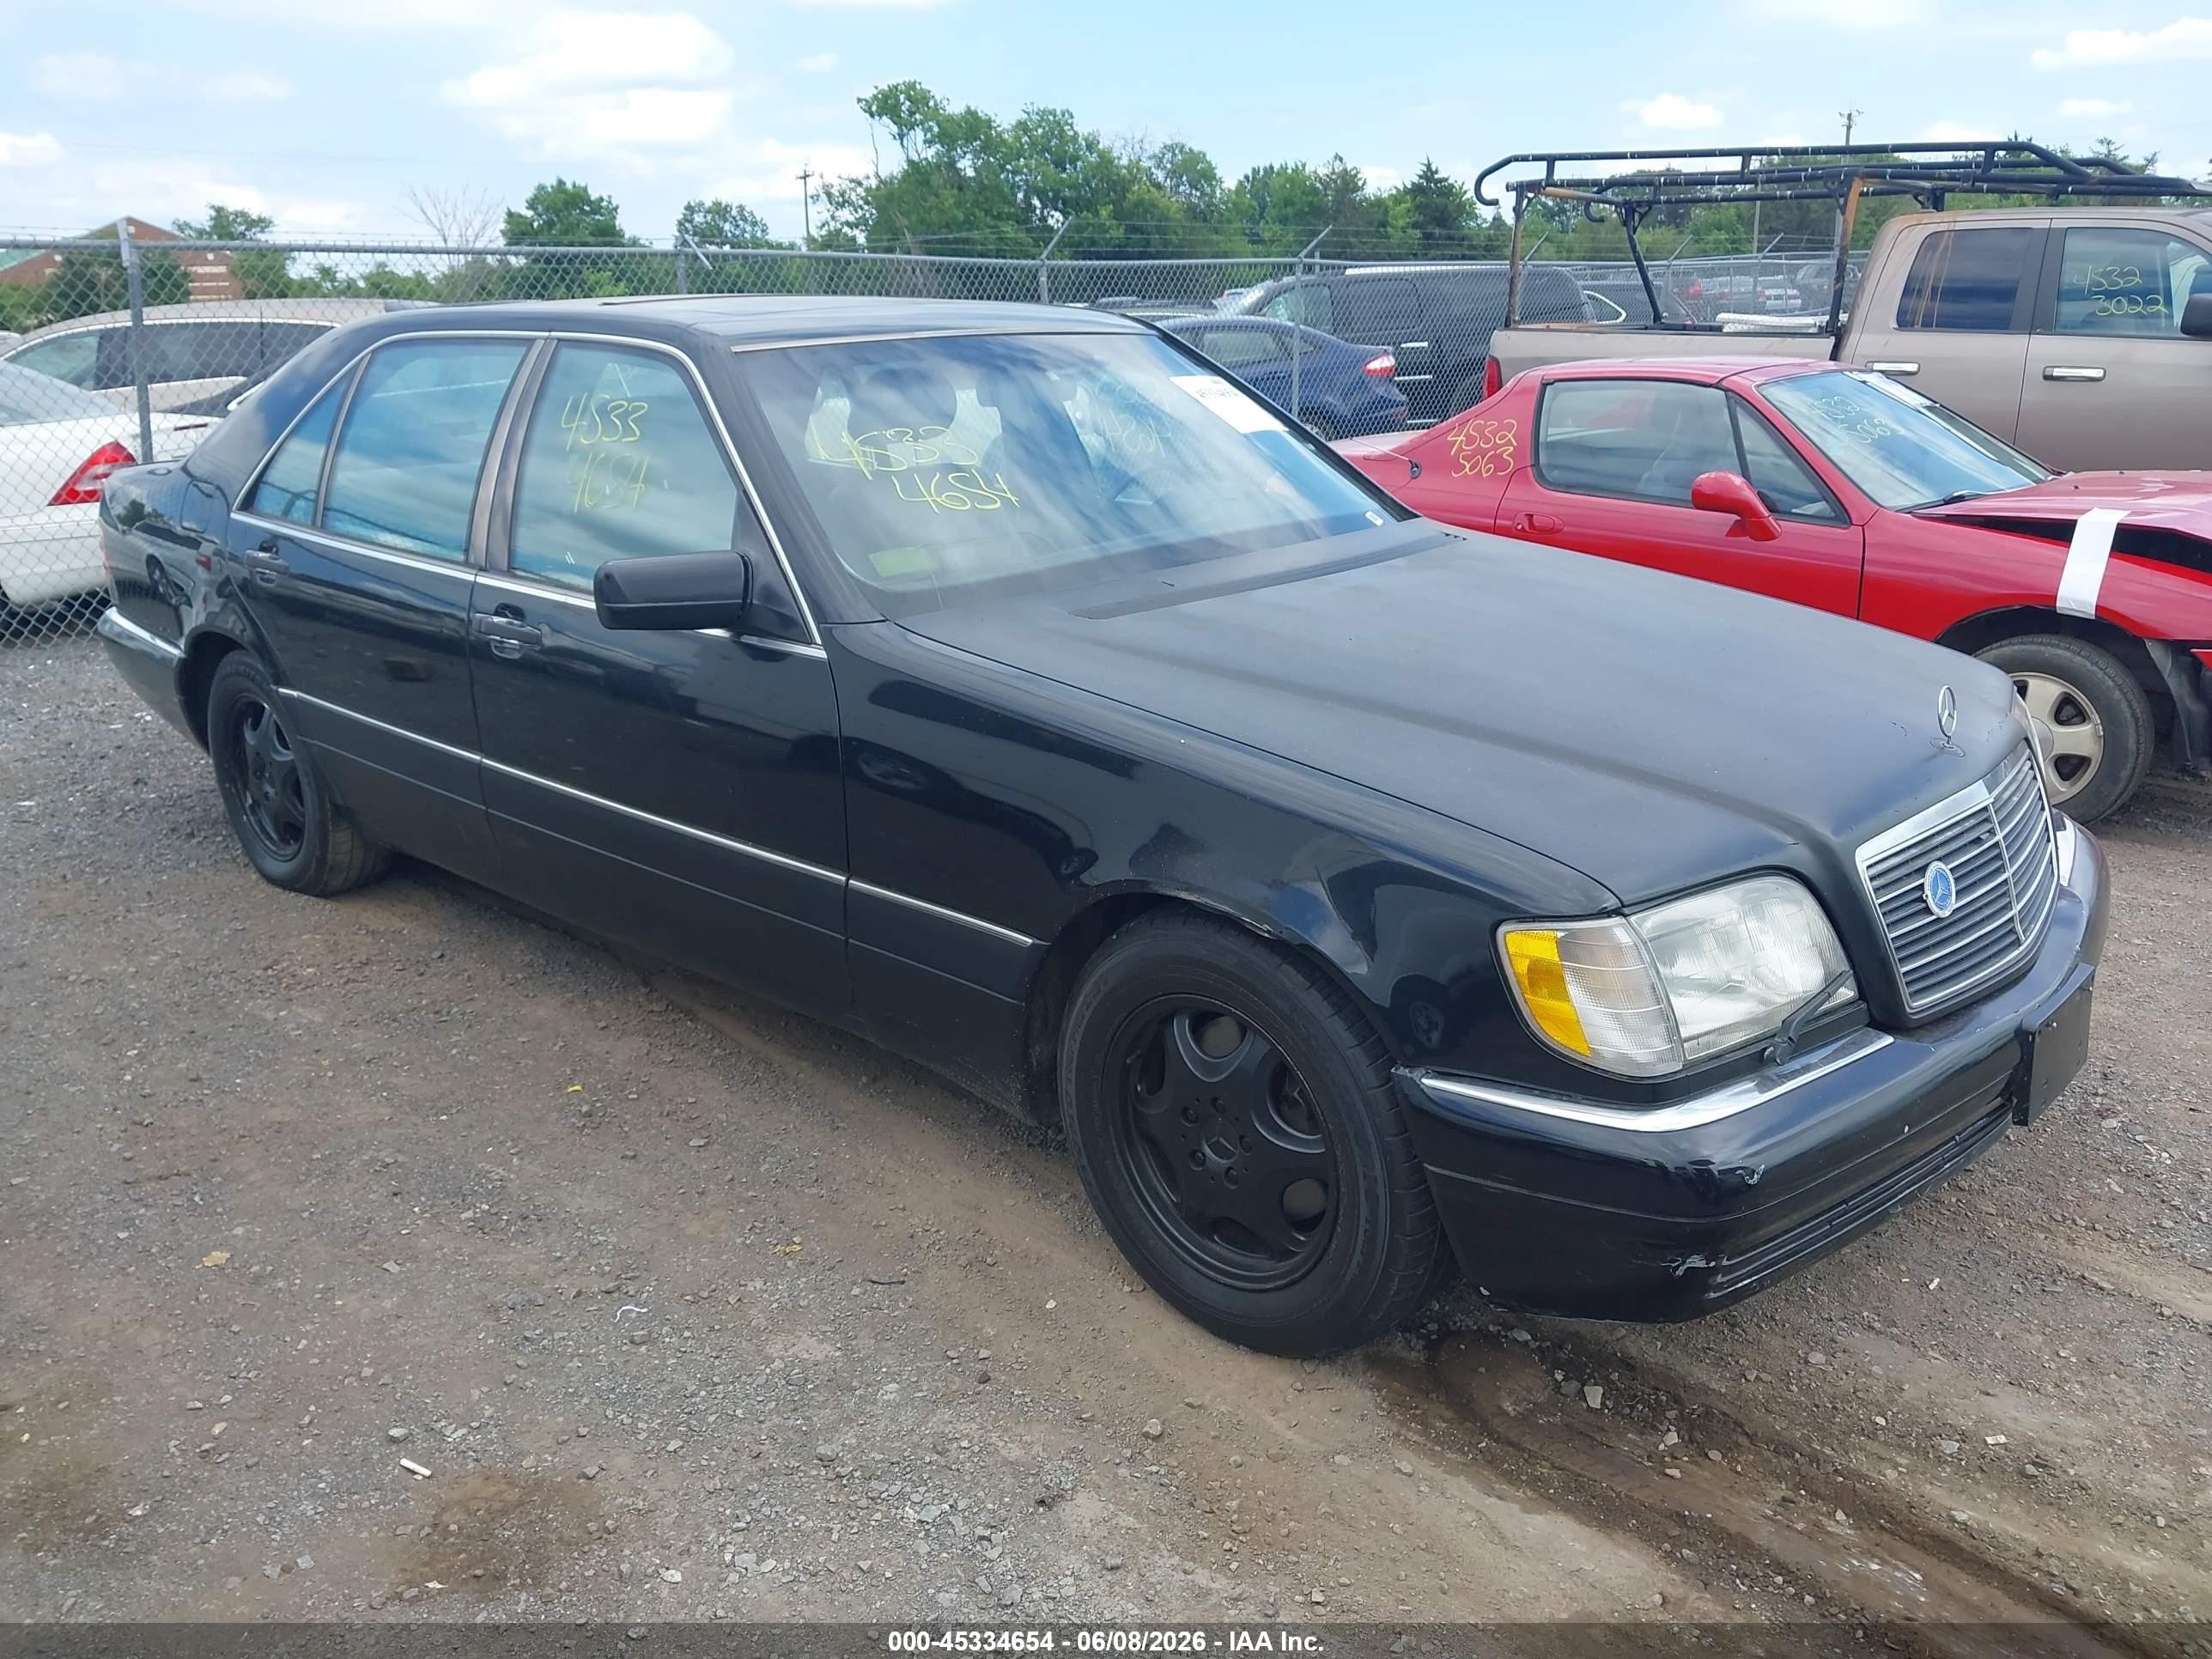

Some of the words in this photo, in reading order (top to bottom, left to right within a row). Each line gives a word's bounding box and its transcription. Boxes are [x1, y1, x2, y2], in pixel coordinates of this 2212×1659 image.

[2073, 264, 2143, 295] 4532
[2090, 294, 2170, 317] 3022
[561, 392, 648, 452] 4533
[1446, 417, 1518, 456] 4532
[811, 416, 979, 480] 4533
[1450, 446, 1515, 478] 5063
[891, 469, 1020, 514] 4654
